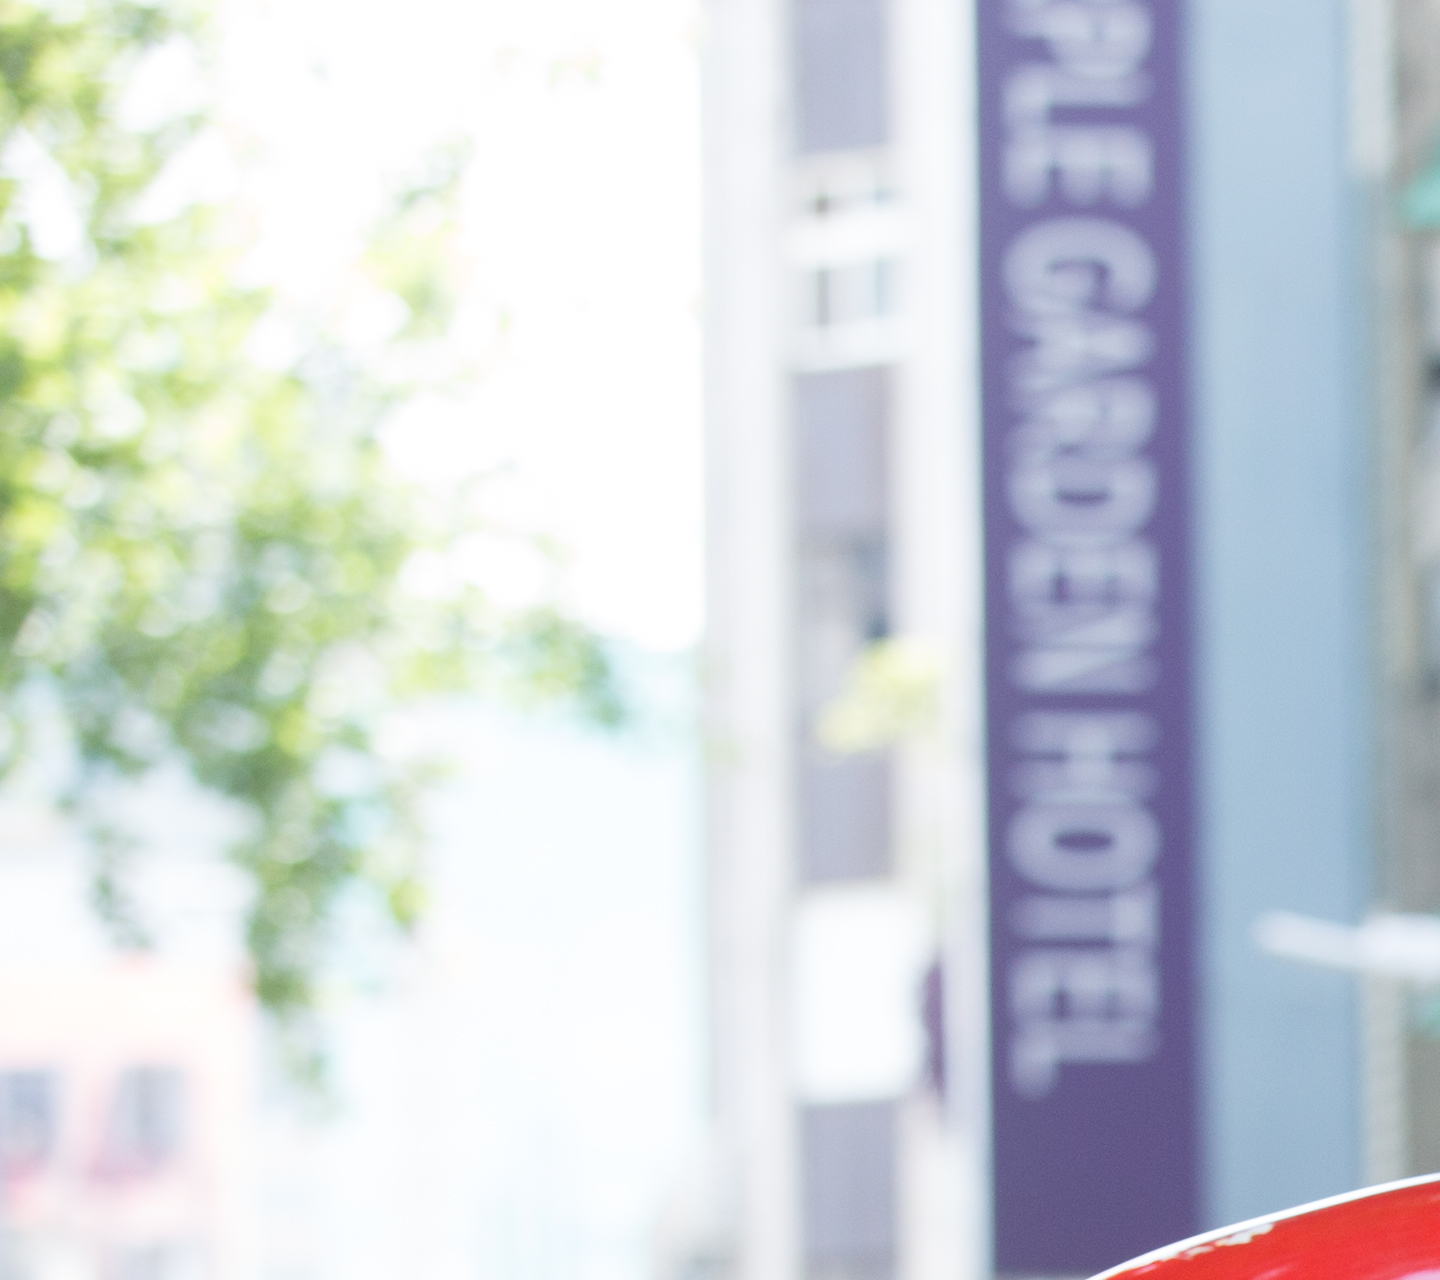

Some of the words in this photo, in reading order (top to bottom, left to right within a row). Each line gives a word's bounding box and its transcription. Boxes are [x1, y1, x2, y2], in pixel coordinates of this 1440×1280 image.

[1000, 0, 1158, 207] PLE
[1003, 216, 1160, 697] GARDEN
[1004, 708, 1162, 1100] HOTEL
